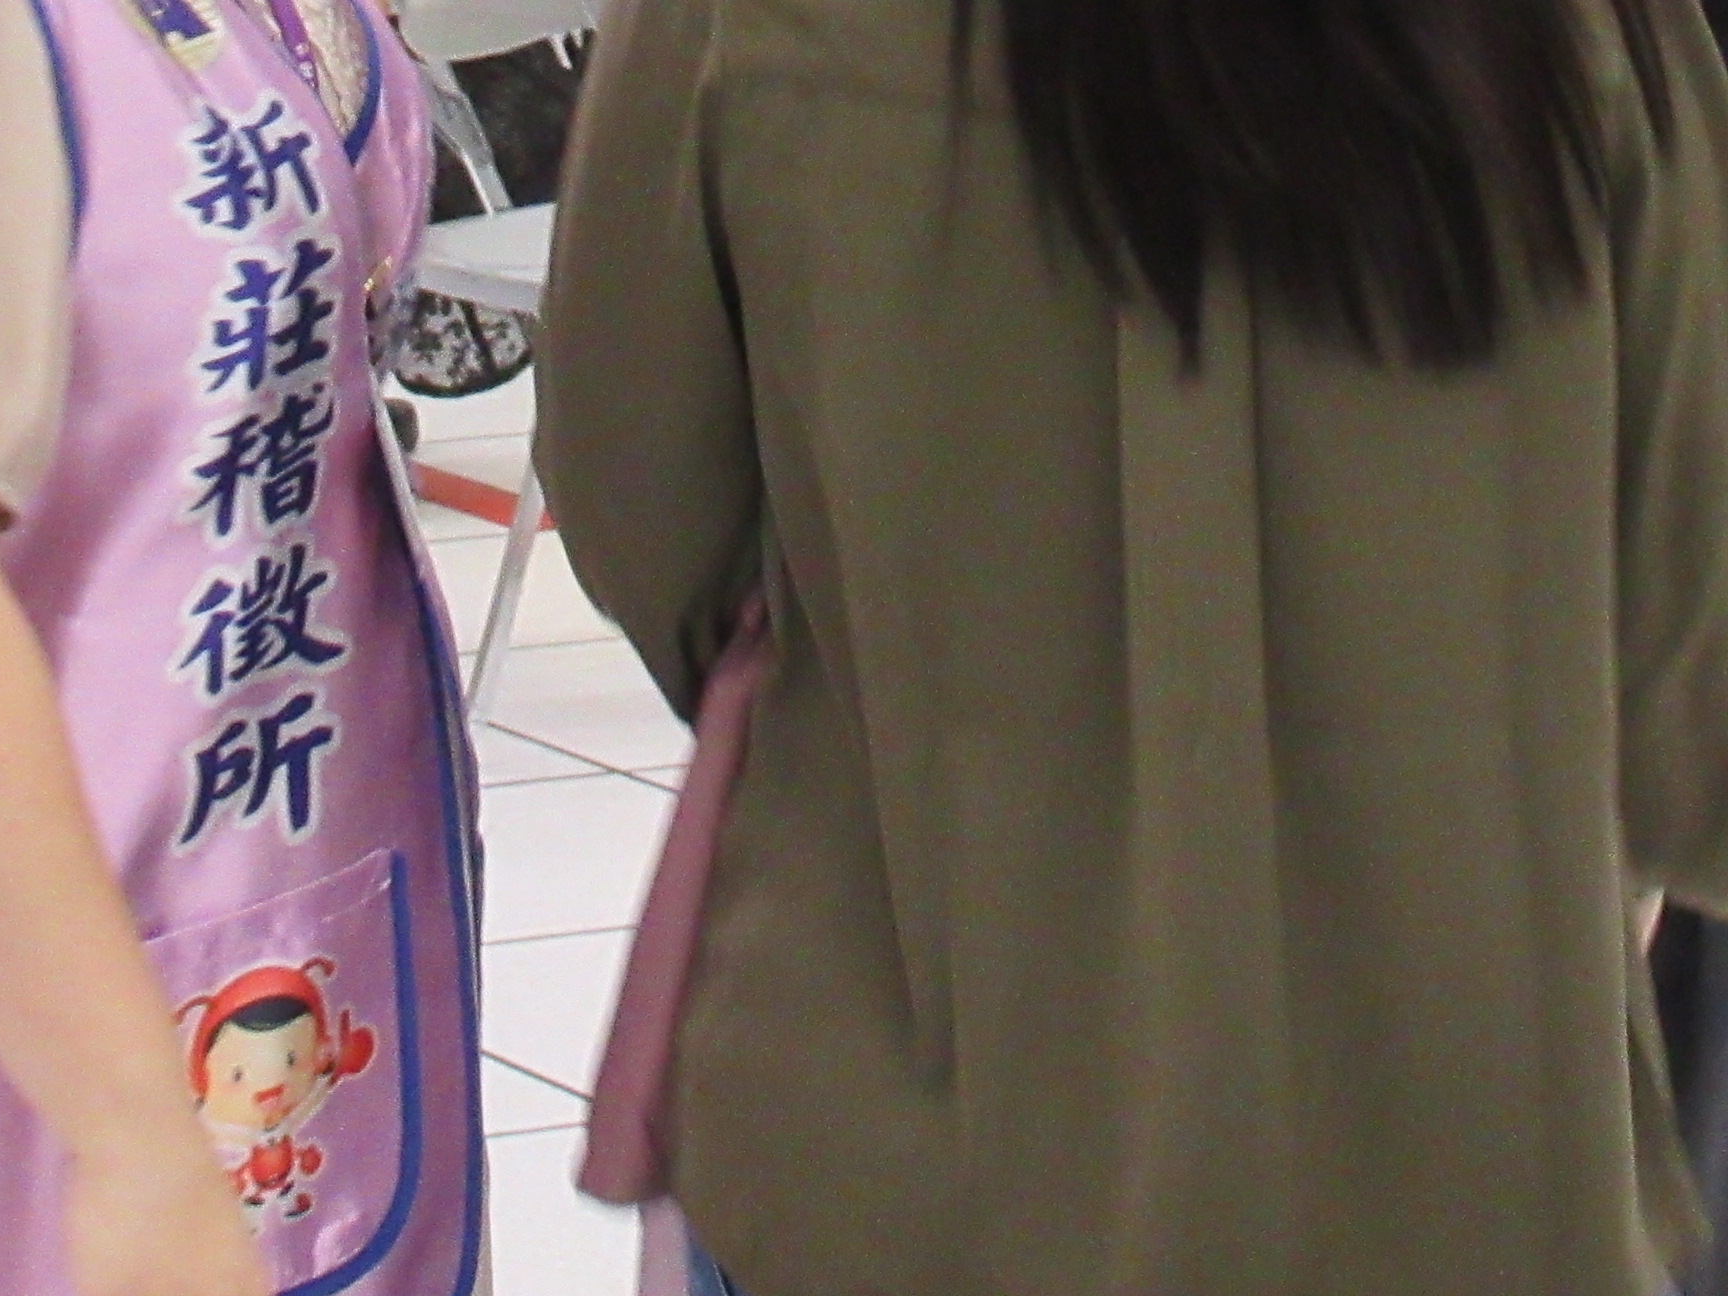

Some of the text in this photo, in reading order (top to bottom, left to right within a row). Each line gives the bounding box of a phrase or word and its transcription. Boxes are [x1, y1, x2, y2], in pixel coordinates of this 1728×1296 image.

[178, 98, 350, 848] 新莊稽徵所
